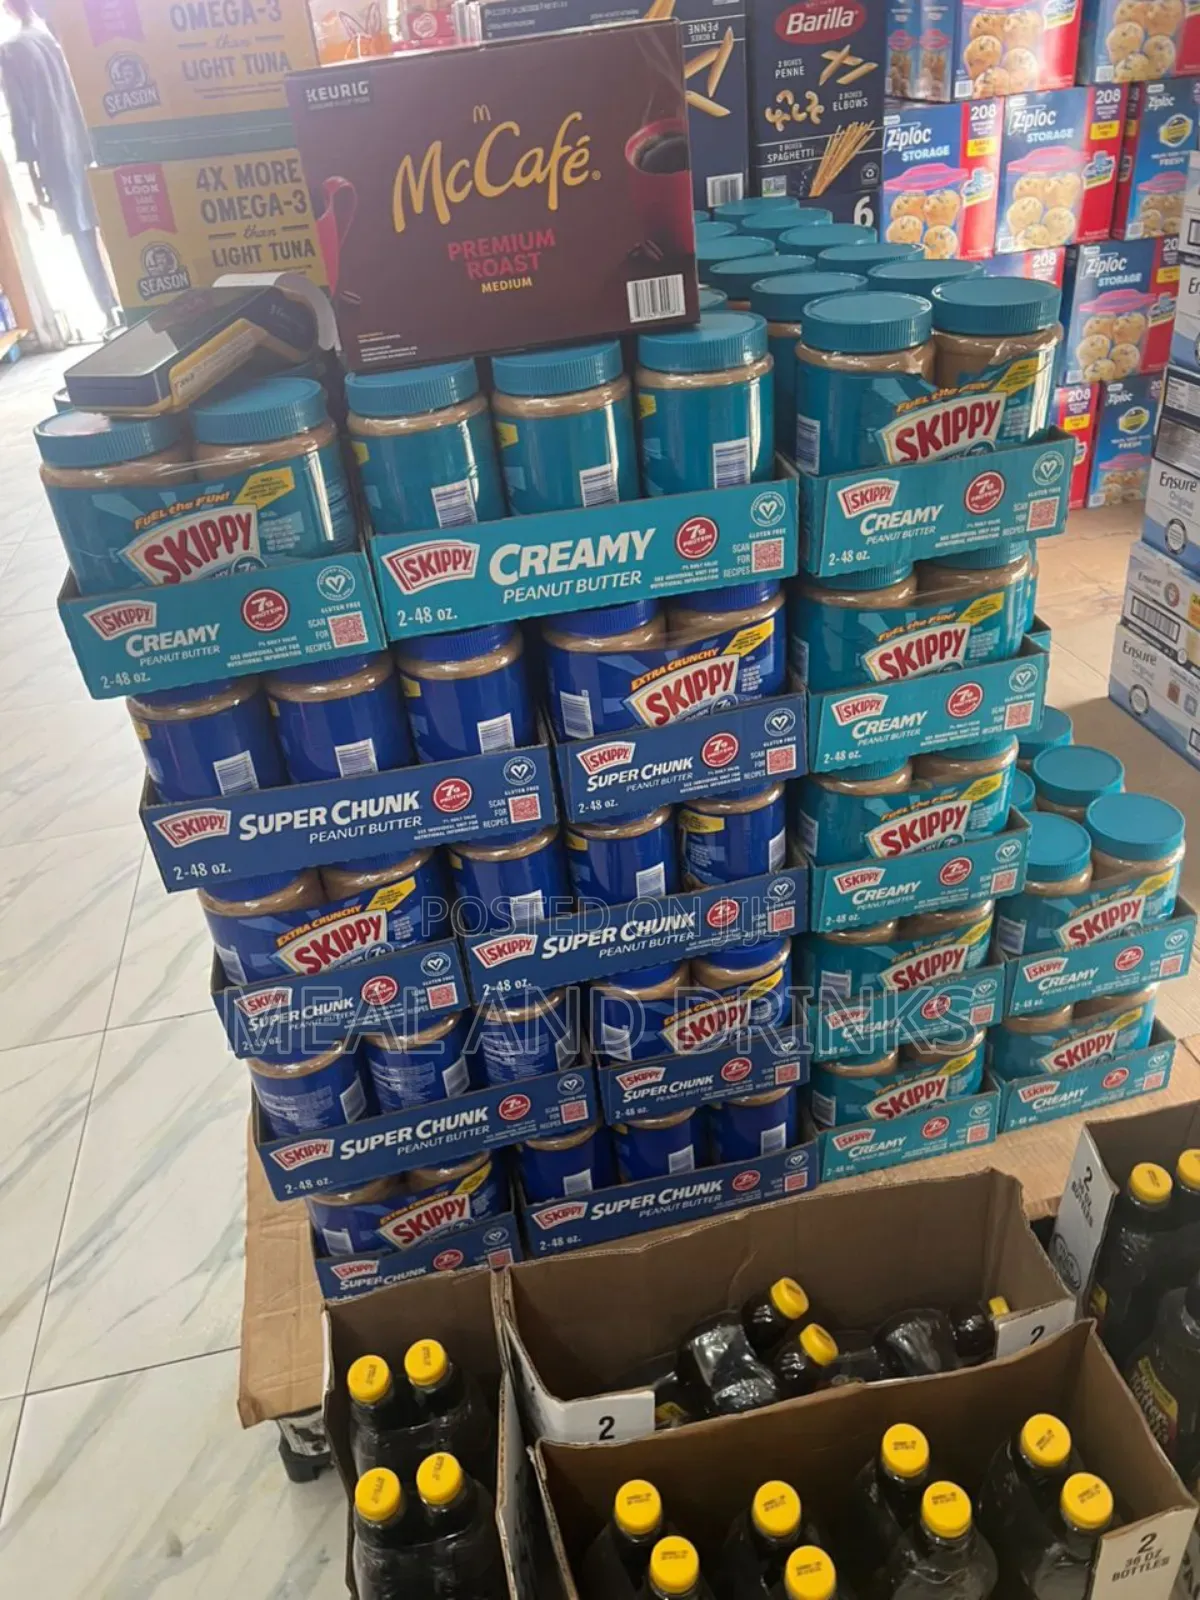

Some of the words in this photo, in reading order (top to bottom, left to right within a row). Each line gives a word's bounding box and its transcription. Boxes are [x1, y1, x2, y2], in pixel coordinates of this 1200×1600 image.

[170, 0, 281, 31] OMEGA-3
[786, 6, 855, 35] Barilla
[181, 57, 236, 81] LIGHT
[244, 52, 292, 73] TUNA
[775, 66, 805, 79] PENNE
[105, 88, 160, 113] SEASON
[306, 80, 370, 103] KEURIG
[832, 97, 869, 111] ELBOWS
[1095, 84, 1121, 105] 208
[970, 104, 997, 121] 208
[1012, 109, 1057, 133] Ziploc
[888, 127, 933, 153] Ziploc
[1027, 128, 1075, 145] STORAGE
[767, 148, 815, 164] SPAGHETTI
[902, 146, 951, 162] STORAGE
[195, 166, 228, 193] 4X
[235, 159, 302, 188] MORE
[200, 192, 307, 224] OMEGA-3
[853, 196, 874, 227] 6
[212, 245, 261, 269] LIGHT
[269, 238, 315, 260] TUNA
[447, 228, 556, 262] PREMIUM
[466, 252, 542, 281] ROAST
[1032, 252, 1057, 268] 208
[1088, 256, 1128, 277] Ziploc
[140, 273, 188, 297] SEASON
[481, 277, 533, 295] MEDIUM
[1098, 273, 1143, 289] STORAGE
[1067, 389, 1091, 402] 208
[895, 399, 1002, 464] SKIPPY
[1159, 471, 1198, 493] Ensure
[850, 484, 893, 511] SKIPPY
[134, 508, 167, 530] FUEL
[859, 504, 944, 537] CREAMY
[144, 512, 252, 584] SKIPPY
[866, 531, 900, 546] PEANUT
[900, 525, 937, 541] BUTTER
[489, 528, 657, 587] CREAMY
[732, 543, 751, 555] SCAN
[737, 554, 752, 565] FOR
[829, 549, 855, 567] 2-48
[404, 552, 473, 585] SKIPPY
[723, 565, 752, 578] RECIPES
[503, 579, 573, 605] PEANUT
[574, 570, 642, 594] BUTTER
[103, 605, 152, 633] SKIPPY
[397, 609, 433, 628] 2-48
[436, 607, 458, 622] oz.
[125, 622, 220, 658] CREAMY
[1122, 639, 1157, 666] Ensure
[139, 650, 181, 667] PEANUT
[181, 644, 221, 663] BUTTER
[878, 628, 967, 681] SKIPPY
[100, 675, 131, 690] 2-48
[133, 674, 152, 685] oz.
[631, 664, 668, 692] EXTRA
[668, 647, 719, 673] CRUNCHY
[645, 661, 735, 727] SKIPPY
[843, 699, 881, 720] SKIPPY
[851, 710, 928, 739] CREAMY
[589, 746, 630, 768] SKIPPY
[586, 768, 640, 794] SUPER
[640, 757, 694, 782] CHUNK
[626, 778, 662, 792] PEANUT
[661, 772, 693, 786] BUTTER
[239, 806, 329, 842] SUPER
[330, 790, 423, 826] CHUNK
[488, 799, 506, 809] SCAN
[493, 808, 508, 818] FOR
[578, 799, 602, 814] 2-48
[604, 798, 619, 809] oz.
[171, 813, 227, 842] SKIPPY
[309, 827, 367, 845] PEANUT
[368, 816, 423, 835] BUTTER
[482, 817, 509, 829] RECIPES
[880, 805, 967, 857] SKIPPY
[173, 863, 208, 882] 2-48
[211, 862, 232, 876] oz.
[843, 872, 880, 889] SKIPPY
[851, 881, 921, 905] CREAMY
[277, 923, 312, 948] EXTRA
[311, 905, 361, 930] CRUNCHY
[1068, 899, 1143, 946] SKIPPY
[294, 915, 382, 976] SKIPPY
[542, 931, 617, 961] SUPER
[619, 912, 697, 945] CHUNK
[599, 939, 647, 959] PEANUT
[648, 931, 695, 949] BUTTER
[486, 939, 532, 962] SKIPPY
[892, 947, 966, 992] SKIPPY
[1037, 967, 1099, 991] CREAMY
[482, 980, 512, 997] 2-48
[514, 979, 533, 990] oz.
[248, 1012, 300, 1033] SUPER
[301, 997, 354, 1020] CHUNK
[677, 1003, 748, 1051] SKIPPY
[1053, 1033, 1115, 1071] SKIPPY
[623, 1086, 669, 1104] SUPER
[669, 1074, 714, 1094] CHUNK
[874, 1078, 945, 1120] SKIPPY
[1032, 1086, 1088, 1110] CREAMY
[340, 1130, 412, 1160] SUPER
[414, 1106, 489, 1141] CHUNK
[397, 1138, 443, 1156] PEANUT
[445, 1125, 490, 1146] BUTTER
[284, 1143, 329, 1165] SKIPPY
[848, 1136, 907, 1157] CREAMY
[285, 1181, 313, 1195] 2-48
[590, 1195, 654, 1221] SUPER
[657, 1179, 724, 1204] CHUNK
[639, 1202, 681, 1219] PEANUT
[681, 1194, 722, 1210] BUTTER
[393, 1195, 467, 1246] SKIPPY
[340, 1277, 381, 1291] SUPER
[383, 1266, 427, 1285] CHUNK
[598, 1415, 616, 1441] 2
[1137, 1532, 1157, 1555] 2
[1112, 1555, 1171, 1582] BOTTLES
